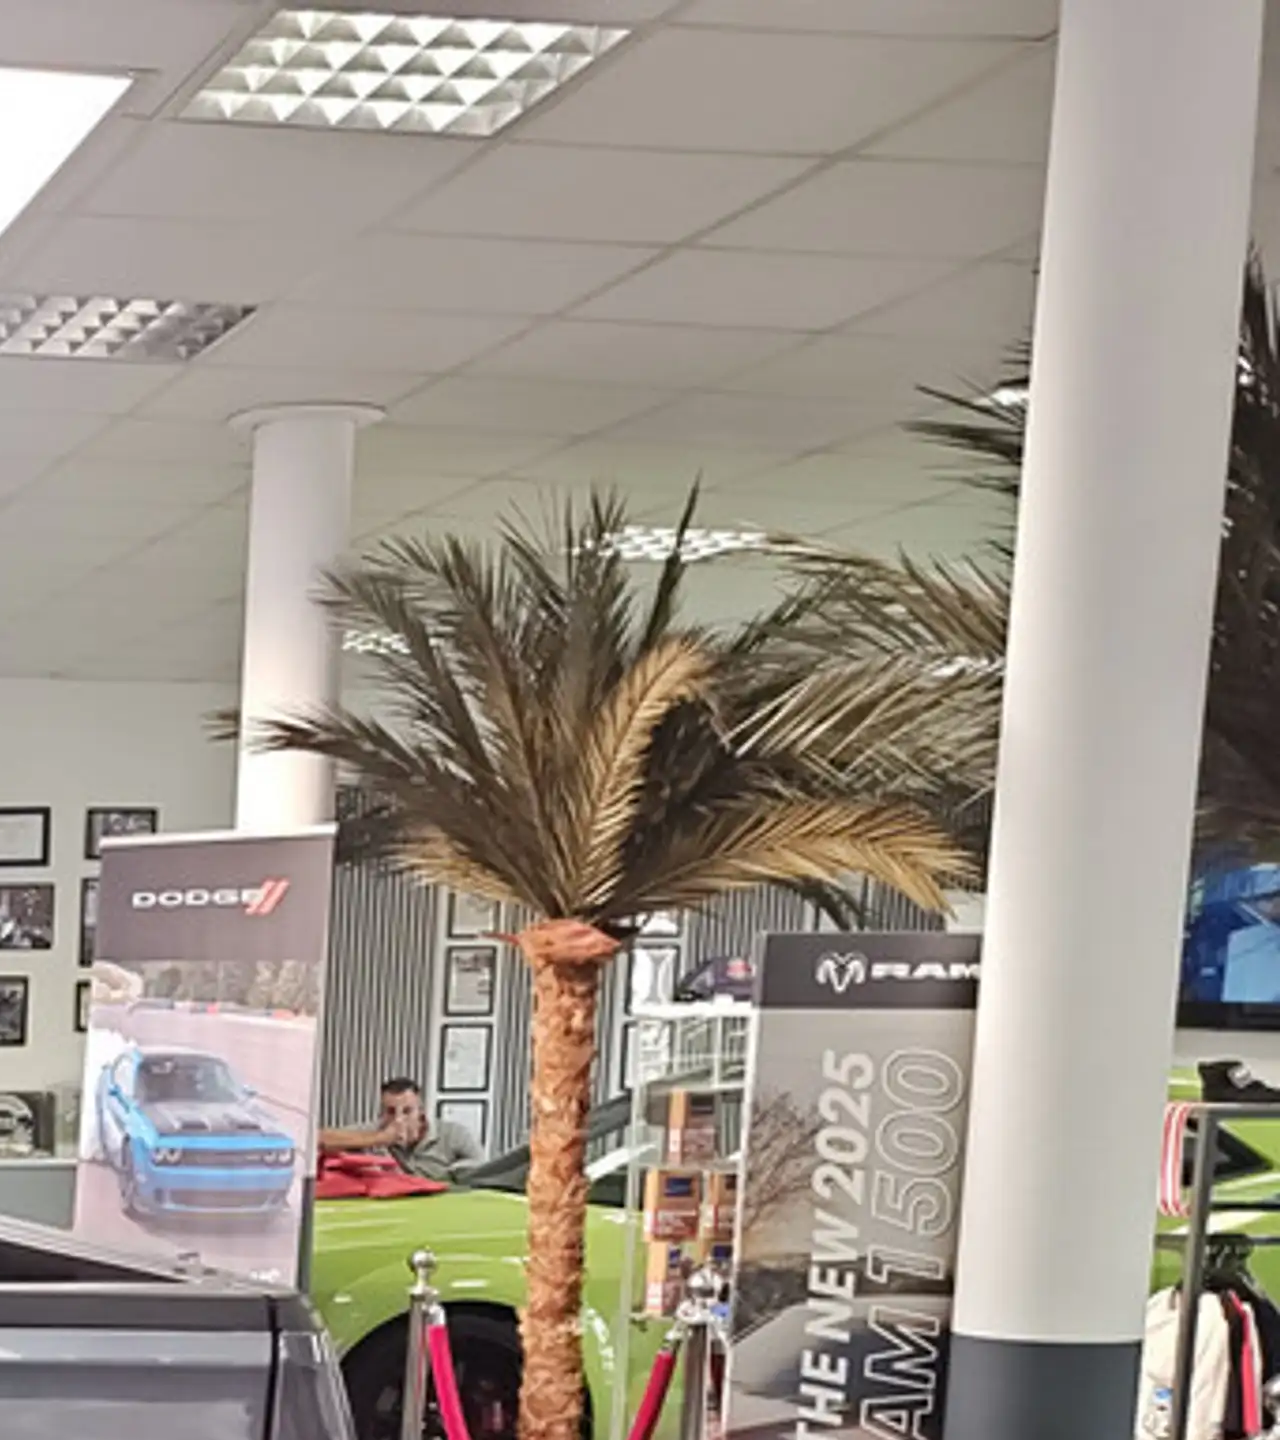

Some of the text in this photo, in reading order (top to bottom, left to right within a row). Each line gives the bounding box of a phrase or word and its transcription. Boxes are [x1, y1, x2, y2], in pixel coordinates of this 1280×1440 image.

[131, 888, 267, 909] DODGE
[871, 962, 981, 980] RAM
[811, 1049, 875, 1205] 2025
[865, 1046, 965, 1284] 1500
[806, 1213, 860, 1343] NEW
